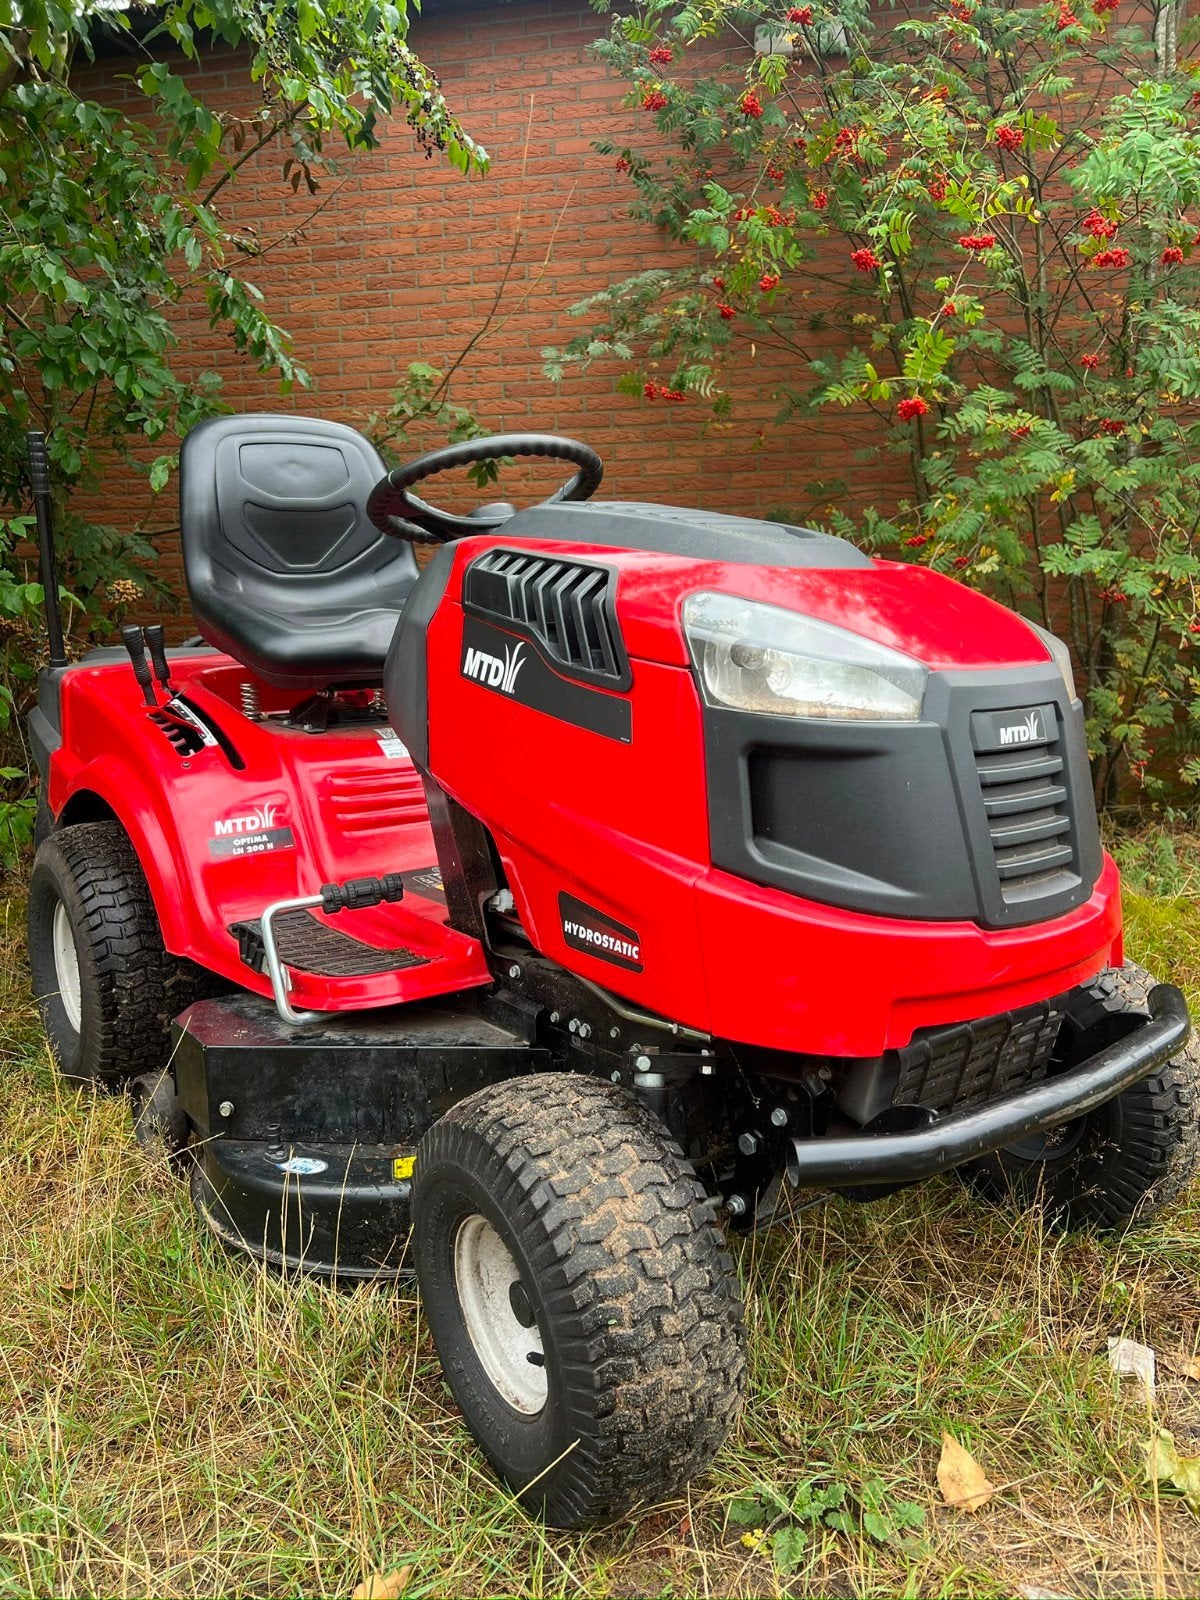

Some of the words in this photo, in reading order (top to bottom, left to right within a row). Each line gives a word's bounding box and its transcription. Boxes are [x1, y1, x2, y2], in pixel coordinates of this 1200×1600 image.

[463, 647, 505, 687] MTD
[1000, 725, 1030, 744] MTD
[214, 815, 261, 835] MTD
[233, 834, 268, 846] OPTIMA
[246, 844, 265, 853] 200
[564, 920, 640, 960] HYDROSTATIC
